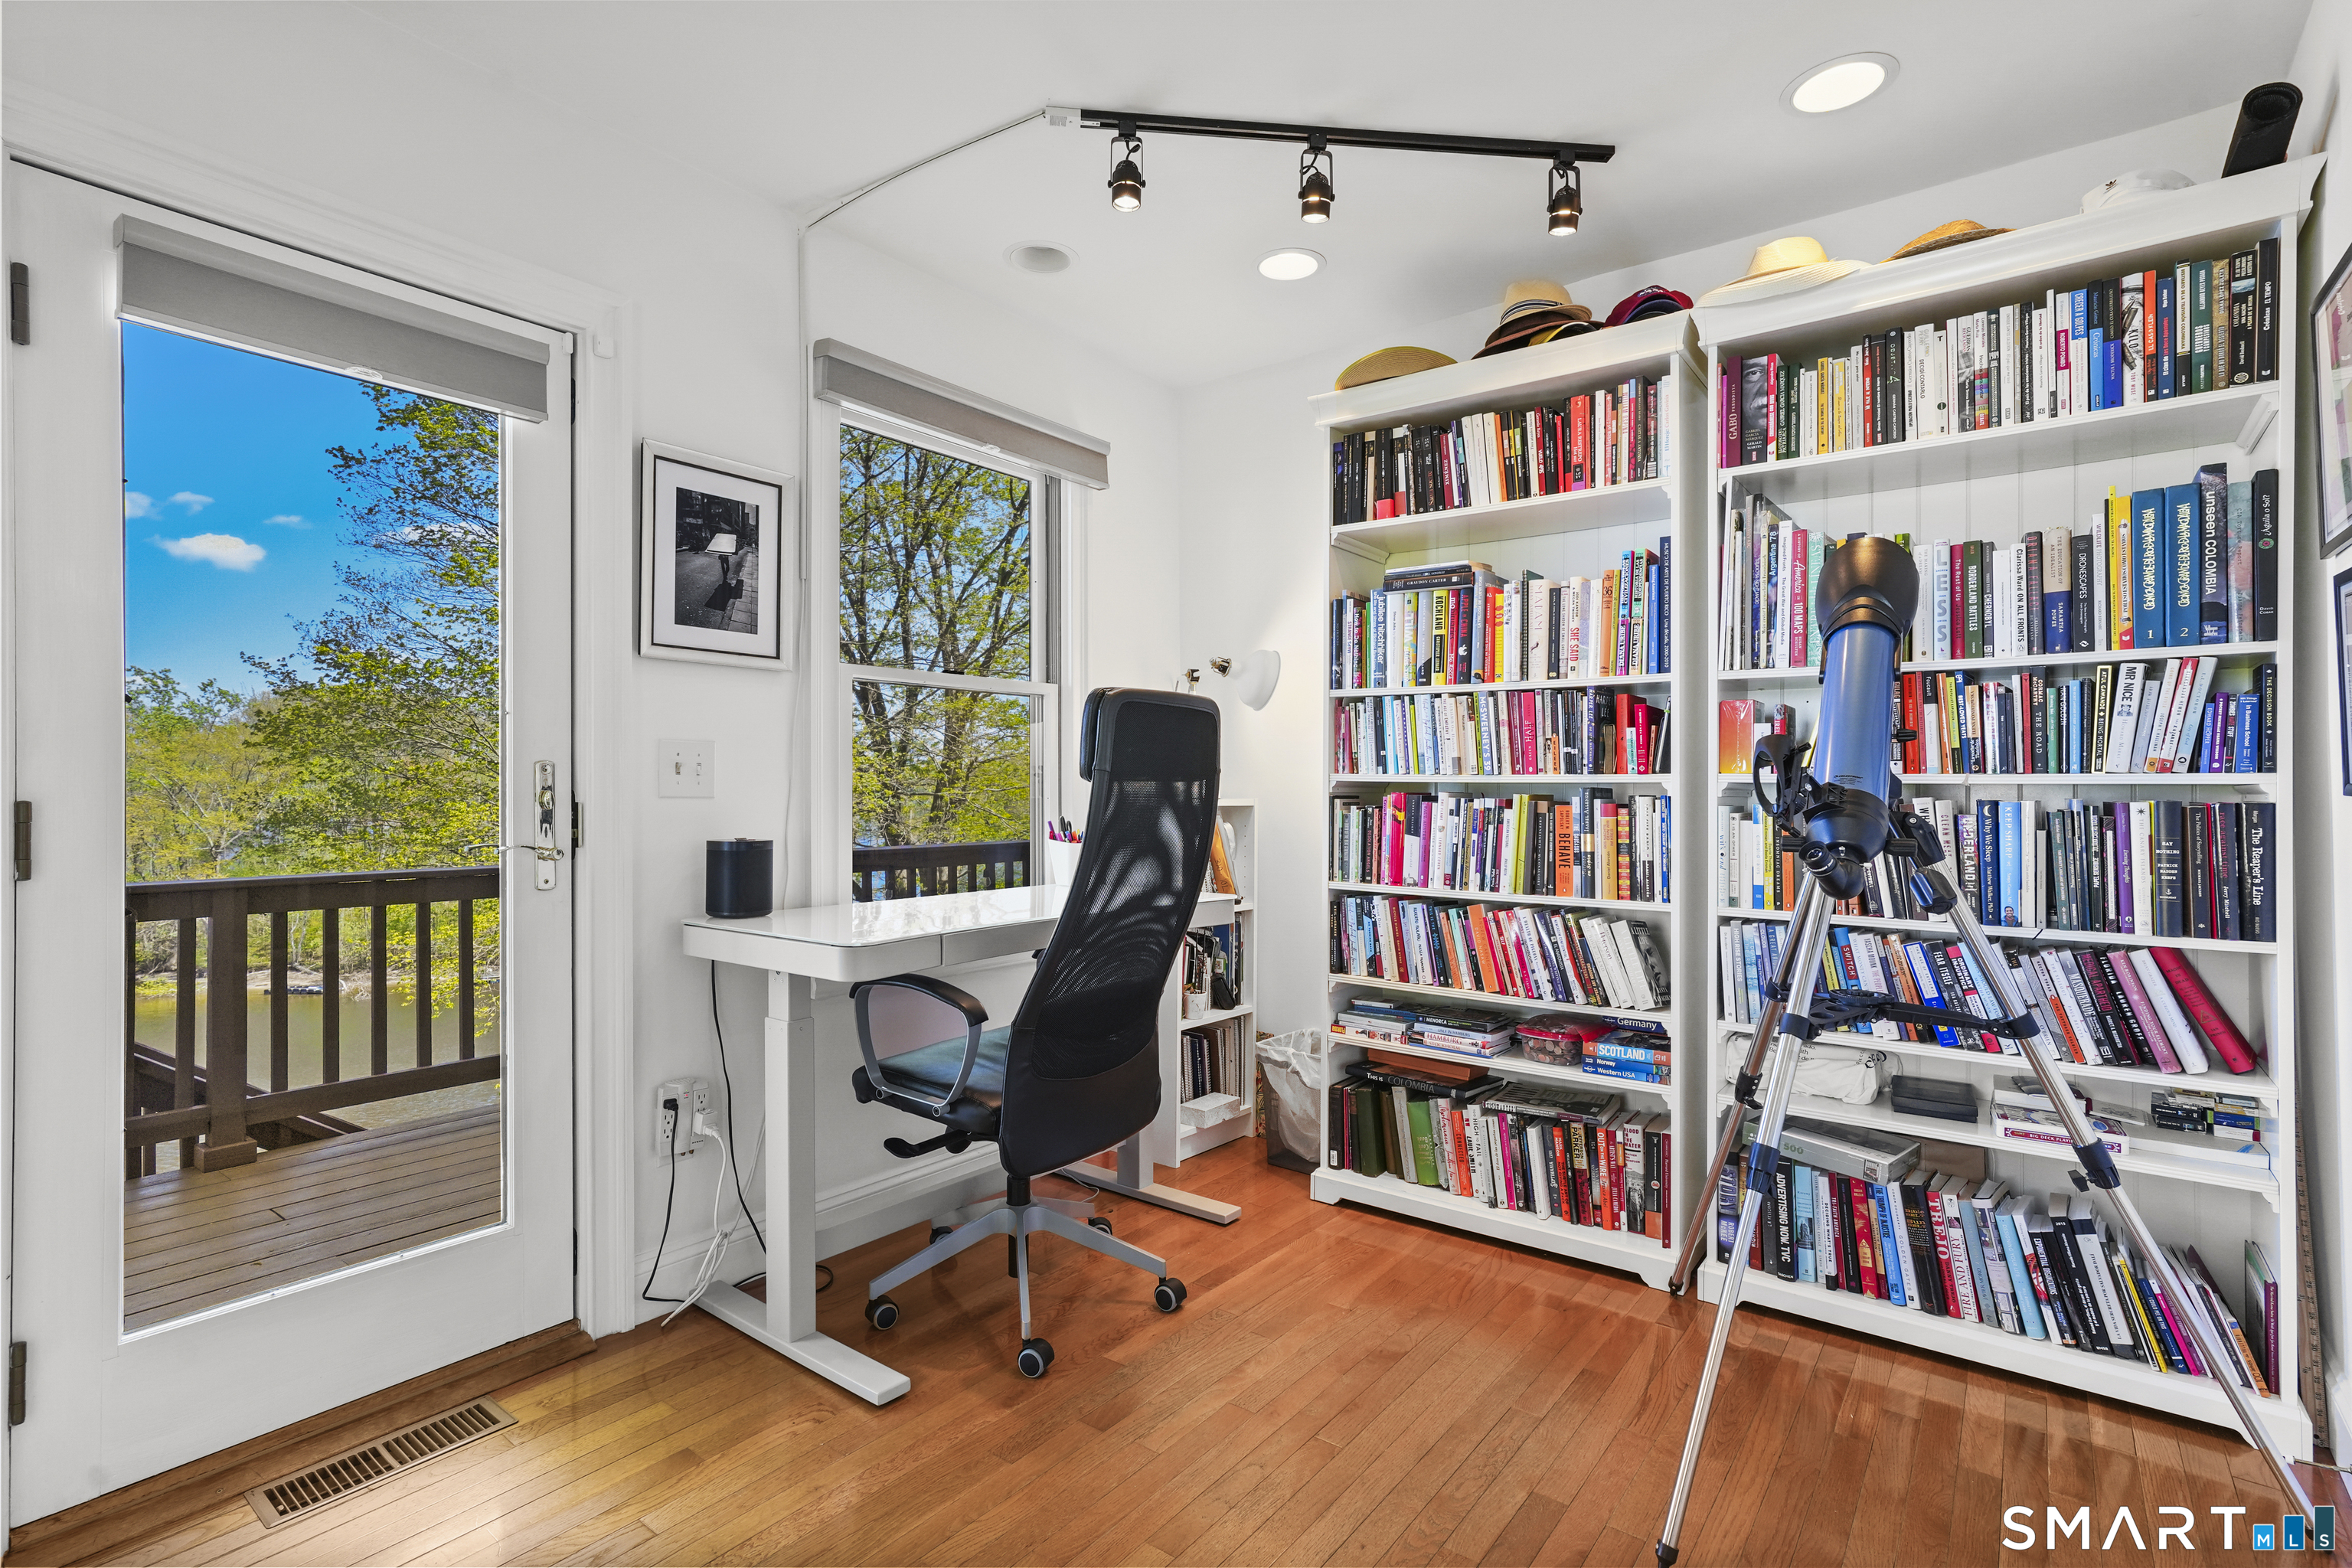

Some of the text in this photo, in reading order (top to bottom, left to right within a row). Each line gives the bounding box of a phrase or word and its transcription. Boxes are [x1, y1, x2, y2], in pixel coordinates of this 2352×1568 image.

[2128, 329, 2138, 348] KILO
[2194, 325, 2203, 353] GUERREROS
[1769, 531, 1777, 576] Argentina '78
[2205, 491, 2217, 595] unseen COLOMBIA
[2027, 536, 2040, 610] ORIANA FALLACI
[2079, 554, 2087, 599] DRONESCAPES
[1603, 586, 1612, 596] 36
[2017, 593, 2024, 602] ON
[1376, 596, 1385, 622] jubilee
[1435, 596, 1444, 630] KOCHLAND
[1534, 585, 1543, 630] MADAM
[1404, 613, 1413, 643] WILL
[2180, 627, 2188, 637] 2
[1570, 627, 1579, 662] SHE SAID
[2121, 666, 2137, 701] MR NICE
[1984, 818, 1992, 833] Why
[1984, 835, 1992, 844] We
[2252, 828, 2262, 844] The
[1559, 833, 1570, 868] BEHAVE
[1963, 818, 1975, 880] UNDERLAND
[1984, 845, 1993, 862] Sleep
[2250, 847, 2264, 883] Reaper's
[2252, 886, 2264, 905] Line
[1842, 947, 1855, 975] SWITCH
[1855, 955, 1864, 972] MONEY
[1933, 952, 1953, 985] FEAR ITSELF
[1952, 959, 1967, 989] INJUSTICE
[1958, 957, 1974, 988] ORDINARY
[2069, 973, 2095, 1016] MASQUERADE
[2082, 954, 2112, 1011] MEDICAL APARTHEID
[2126, 970, 2138, 991] ROBINSON
[1974, 977, 1992, 1014] MARTHA MINOW
[2100, 956, 2144, 1040] FLORIDA LAUREN GROFF
[1426, 1017, 1447, 1025] MENORCA
[1617, 1017, 1657, 1031] Germany
[2141, 1001, 2168, 1054] FINDING YOUR ELEMENT
[2162, 1001, 2177, 1027] CURIOUS MIND
[1427, 1032, 1462, 1044] HAMBURG
[1429, 1040, 1461, 1050] STOCKHOLM
[2040, 1024, 2052, 1046] O'BRIEN
[1597, 1059, 1615, 1067] Norway
[1599, 1044, 1645, 1060] SCOTLAND
[1597, 1067, 1622, 1076] Western
[1456, 1133, 1465, 1162] CONNECTED
[1784, 1142, 1804, 1155] 500
[1723, 1170, 1737, 1212] STORY
[1776, 1173, 1791, 1263] ADVERTISING NOW. TVC
[1928, 1199, 1949, 1259] TREJO
[1945, 1262, 1953, 1282] DANNY
[2002, 1224, 2020, 1278] DESIGNING YOUR LIFE
[1951, 1236, 1973, 1316] FIRE AND FURY
[1976, 1268, 1984, 1284] MORO
[2034, 1238, 2057, 1295] EXPONENTIAL ORGANIZATIONS
